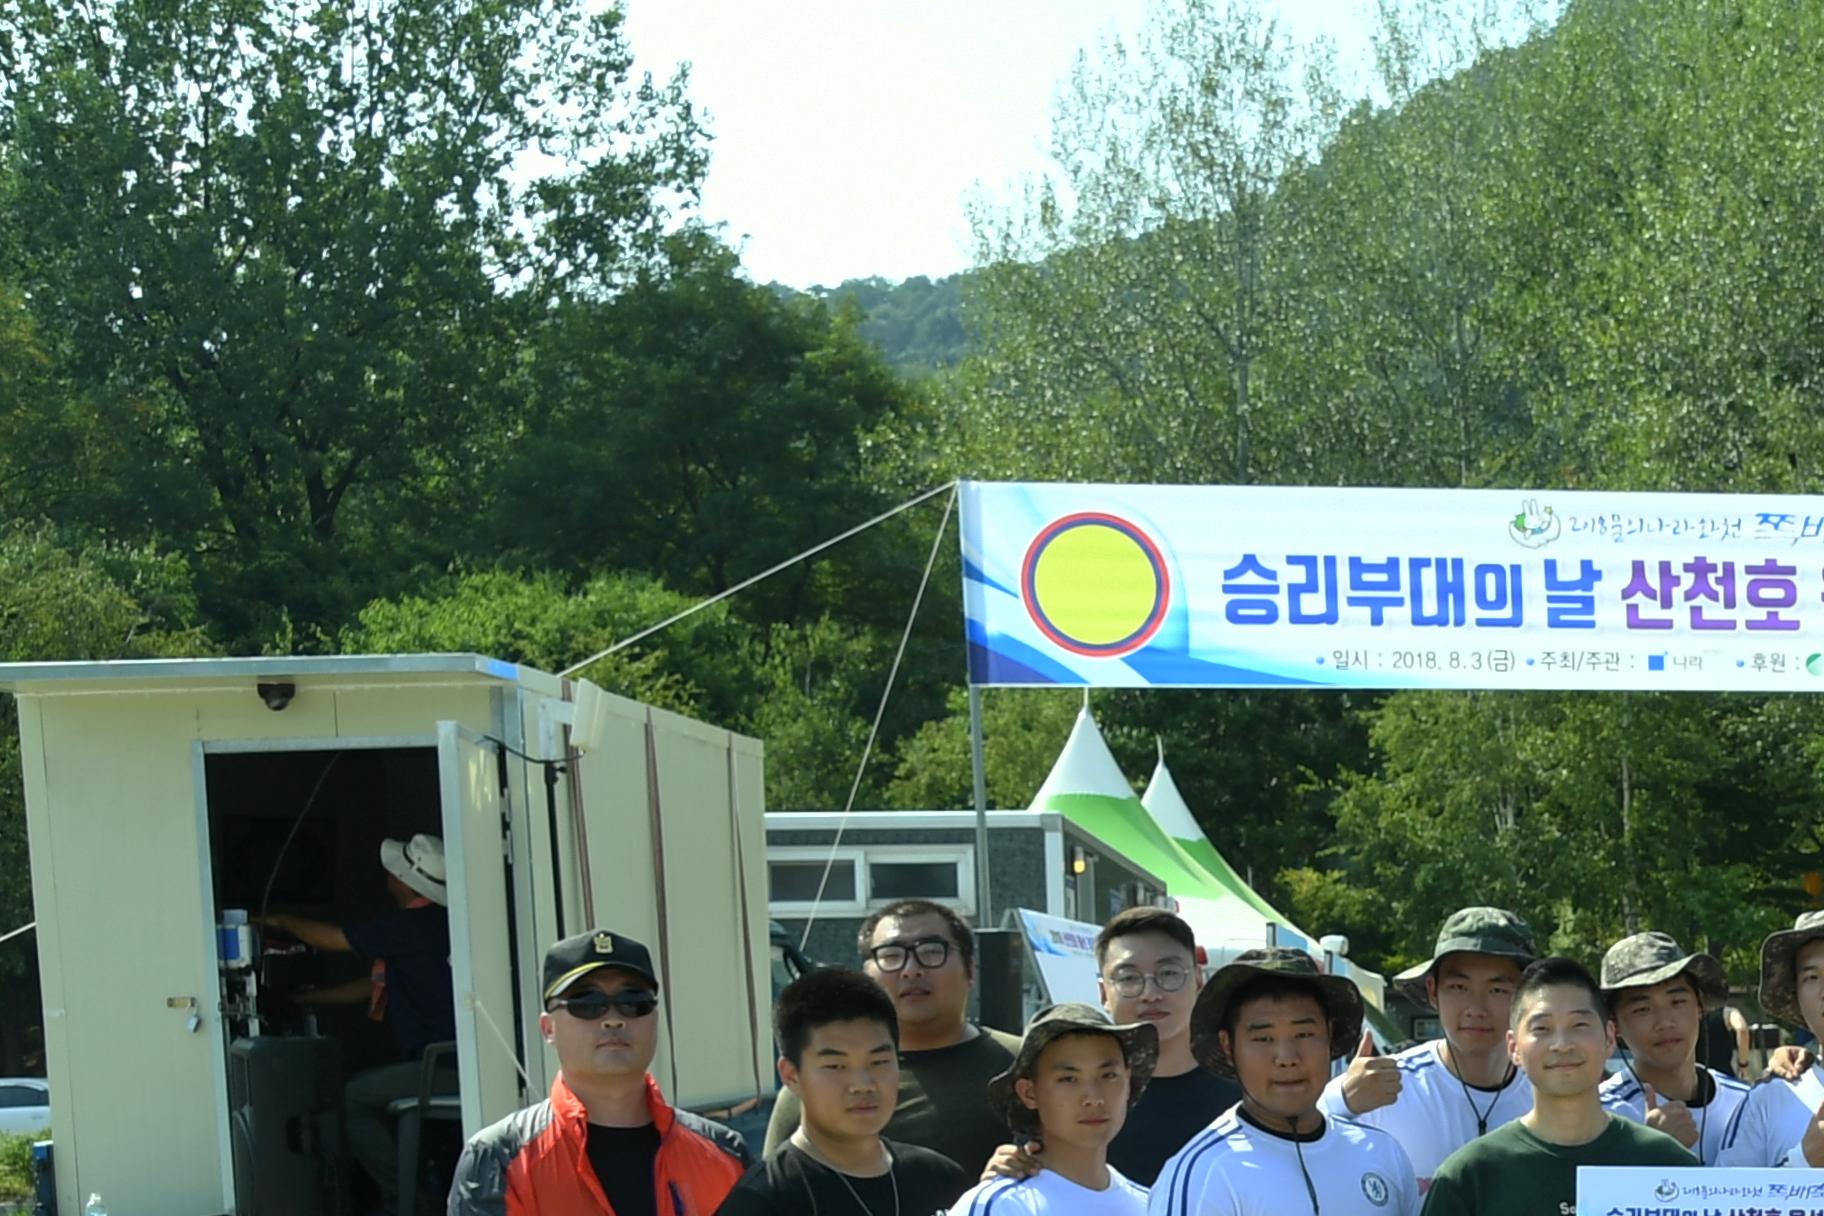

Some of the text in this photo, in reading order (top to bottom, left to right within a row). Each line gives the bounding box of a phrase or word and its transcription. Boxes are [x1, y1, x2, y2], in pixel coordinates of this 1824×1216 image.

[1221, 553, 1524, 627] 승리부대의
[1543, 559, 1603, 629] 날
[1621, 556, 1800, 631] 산천호
[1332, 649, 1369, 671] 일시
[1540, 650, 1620, 671] 주최/주관
[1751, 652, 1786, 673] 후원
